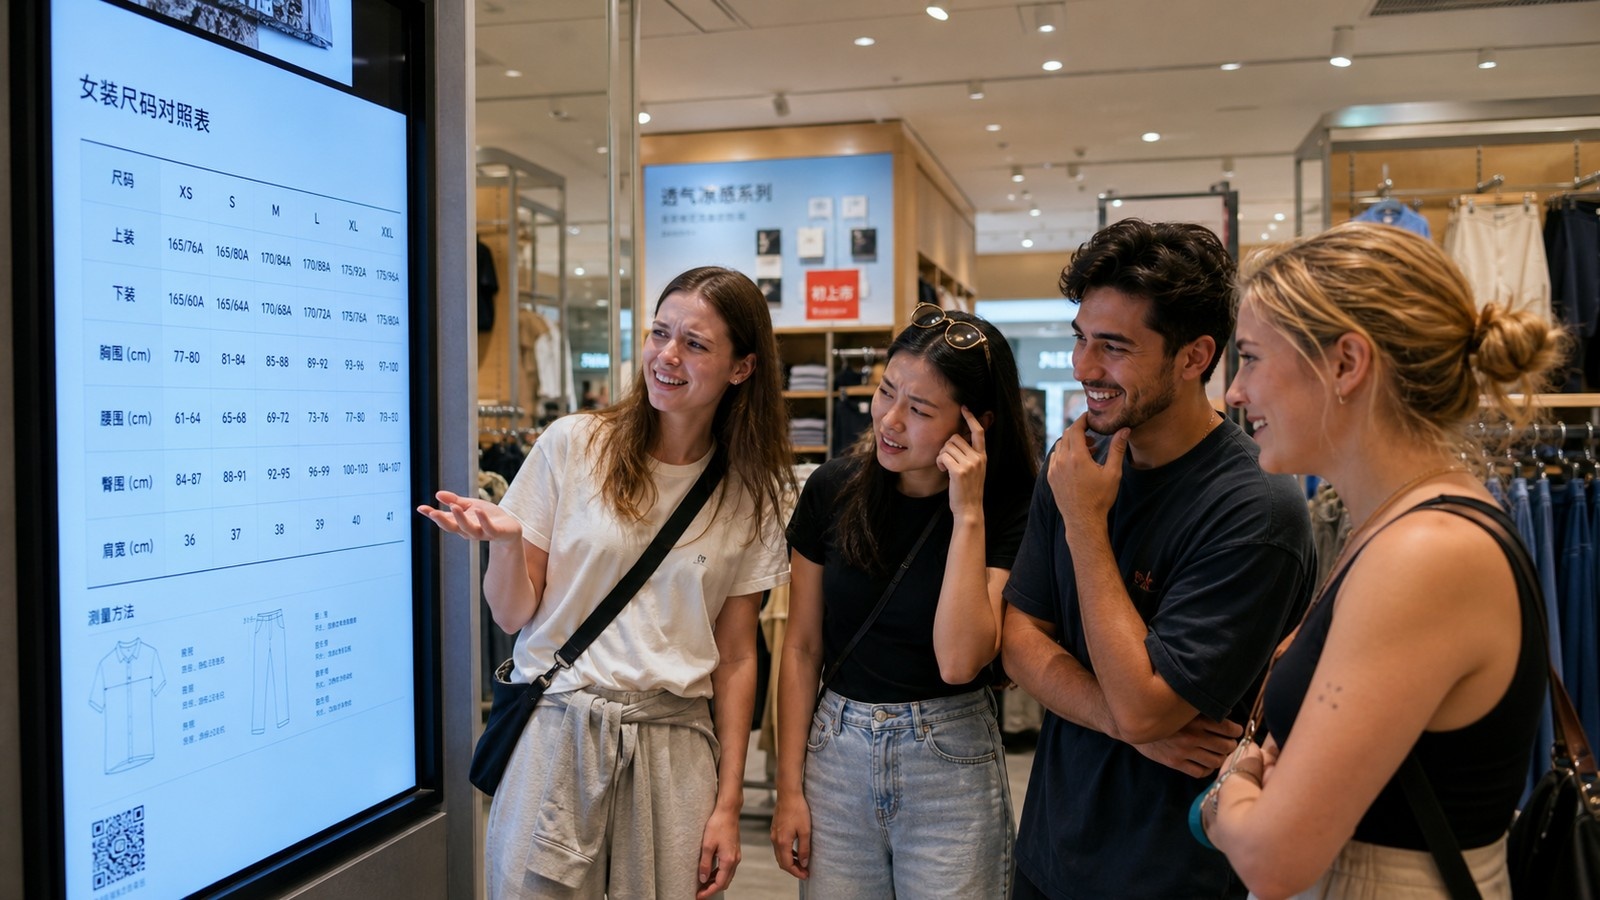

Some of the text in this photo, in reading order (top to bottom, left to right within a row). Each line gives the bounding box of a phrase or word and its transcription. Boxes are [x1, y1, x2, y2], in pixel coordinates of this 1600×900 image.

[80, 74, 210, 133] 女装尺码对照表
[112, 170, 393, 238] 尺码 XS S M L XL XXL
[661, 183, 773, 207] 透气凉感系列
[112, 228, 134, 245] 上装
[168, 238, 203, 254] 165/76A
[216, 246, 249, 260] 165/80A
[261, 252, 291, 266] 170/84A
[303, 259, 331, 272] 170/88A
[342, 265, 366, 277] 175/92A
[112, 285, 135, 302] 下装
[169, 293, 204, 307] 165/60A
[217, 298, 249, 312] 165/64A
[262, 303, 292, 315] 170/68A
[304, 307, 331, 319] 170/72A
[342, 311, 367, 322] 175/76A
[100, 345, 398, 372] 胸围 (cm) 77-80 81-84 85-88 89-92 93-96 97-100
[100, 411, 123, 426] 腰围
[128, 411, 152, 426] (cm)
[175, 412, 200, 424] 61-64
[222, 412, 246, 423] 65-68
[267, 412, 289, 423] 69-72
[308, 412, 329, 422] 73-76
[346, 412, 365, 422] 77-80
[102, 462, 401, 492] 臀围 (cm) 84-87 88-91 92-95 96-99 100-103 104-107
[103, 512, 394, 558] 肩宽 (cm) 36 37 38 39 40 41
[88, 604, 134, 626] 测量方法
